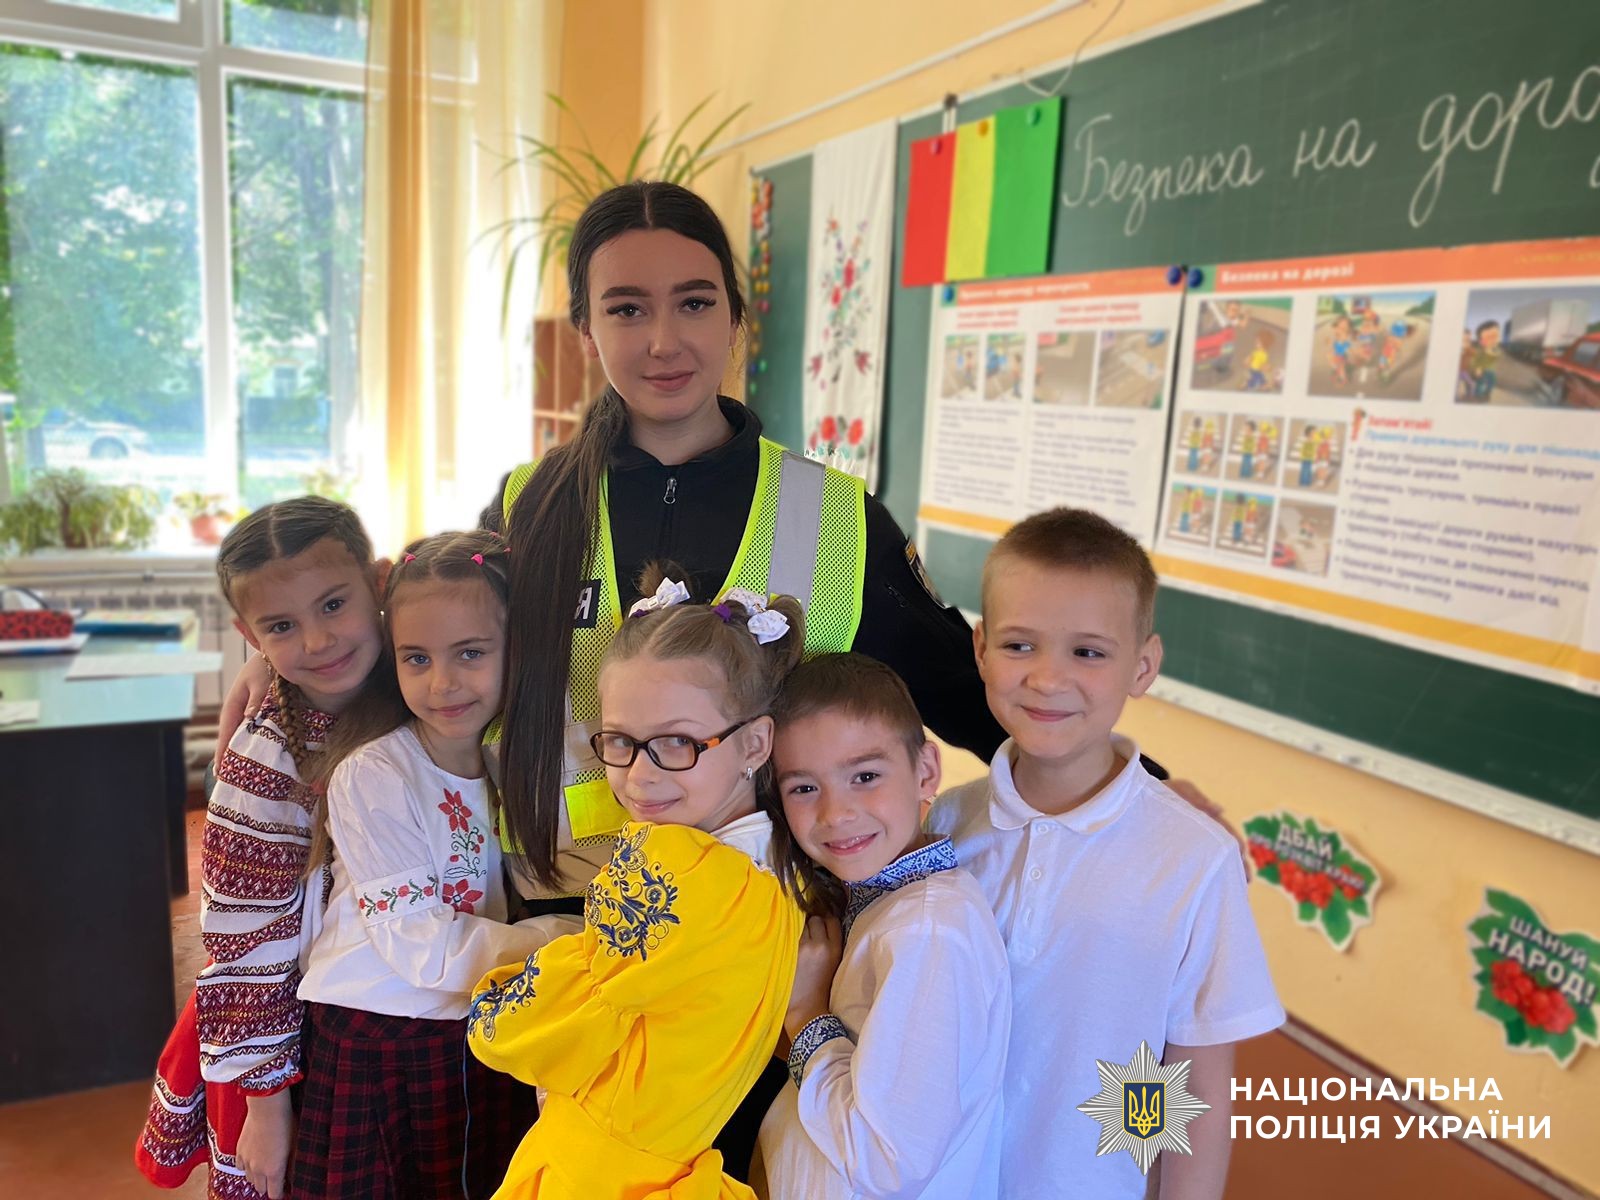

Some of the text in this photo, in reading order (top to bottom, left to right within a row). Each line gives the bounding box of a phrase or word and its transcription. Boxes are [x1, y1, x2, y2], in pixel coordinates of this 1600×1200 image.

[1063, 65, 1600, 236] Безпека на доро
[1275, 823, 1334, 861] ДБАЙ
[1488, 927, 1596, 1006] НАРОД!
[1509, 915, 1589, 971] ШАНУЙ
